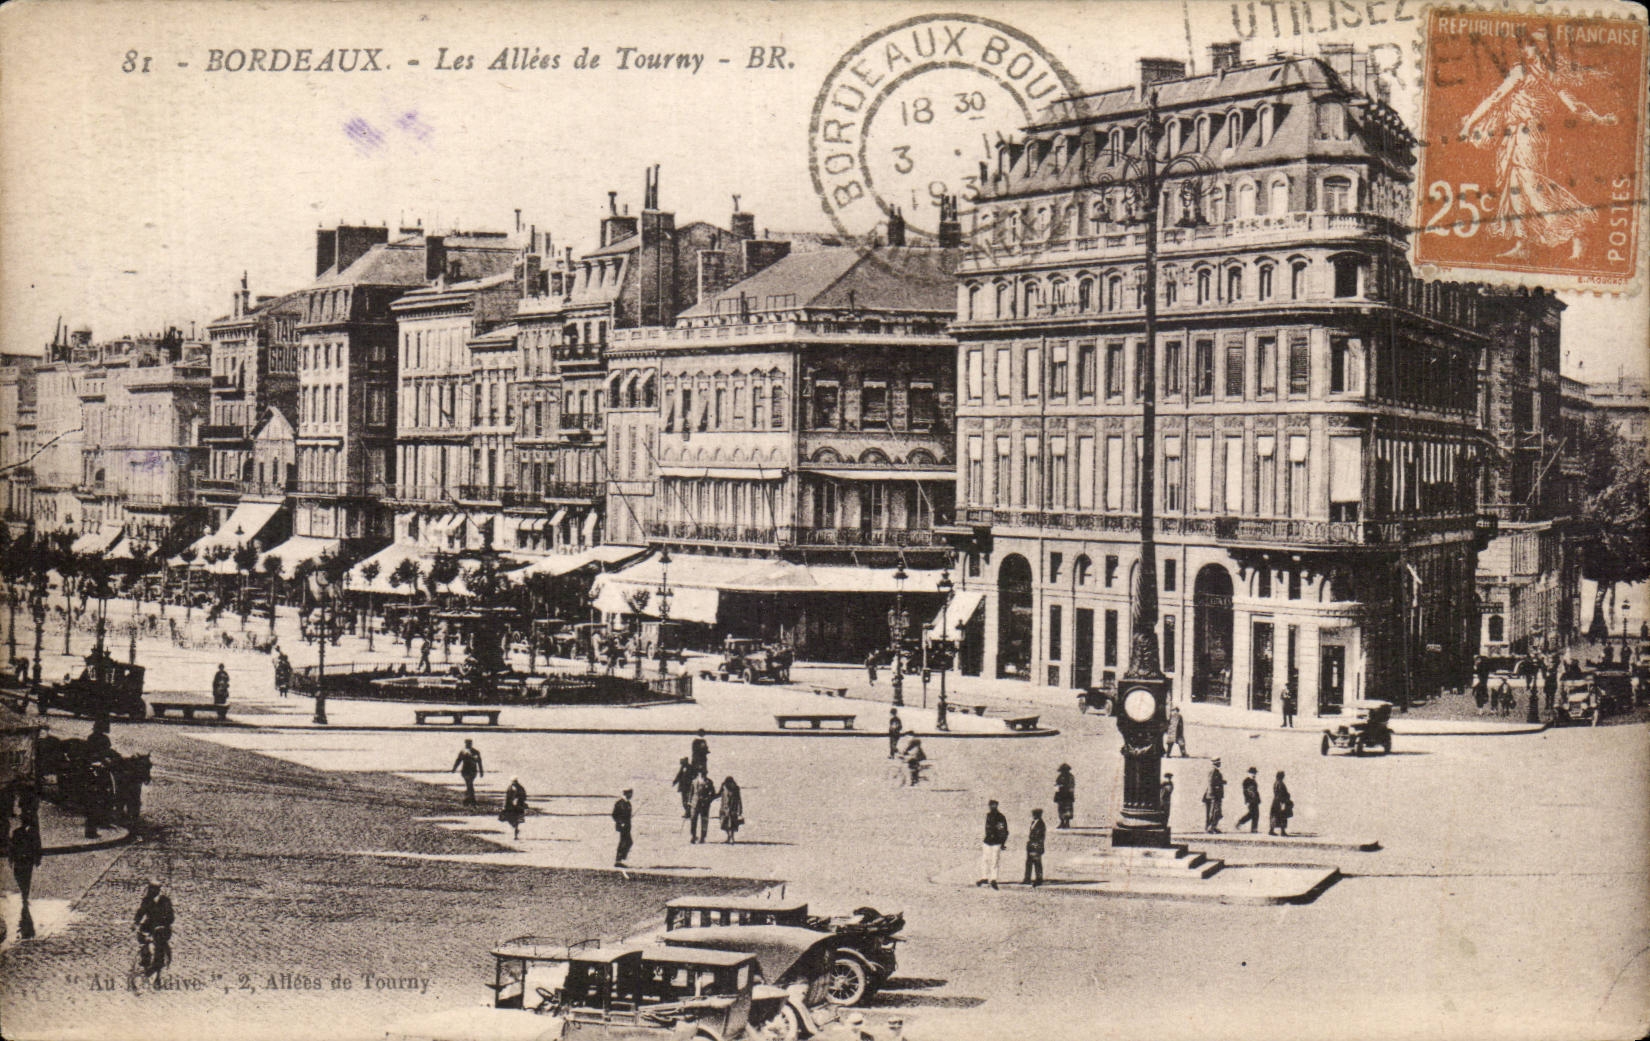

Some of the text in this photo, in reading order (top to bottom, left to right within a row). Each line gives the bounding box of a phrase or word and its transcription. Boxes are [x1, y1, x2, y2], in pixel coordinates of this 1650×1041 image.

[1231, 0, 1415, 40] UTILISEZ
[822, 25, 967, 209] BORDEAUX
[901, 91, 986, 126] 18 30
[893, 145, 914, 174] 3
[1607, 176, 1631, 262] POSTES
